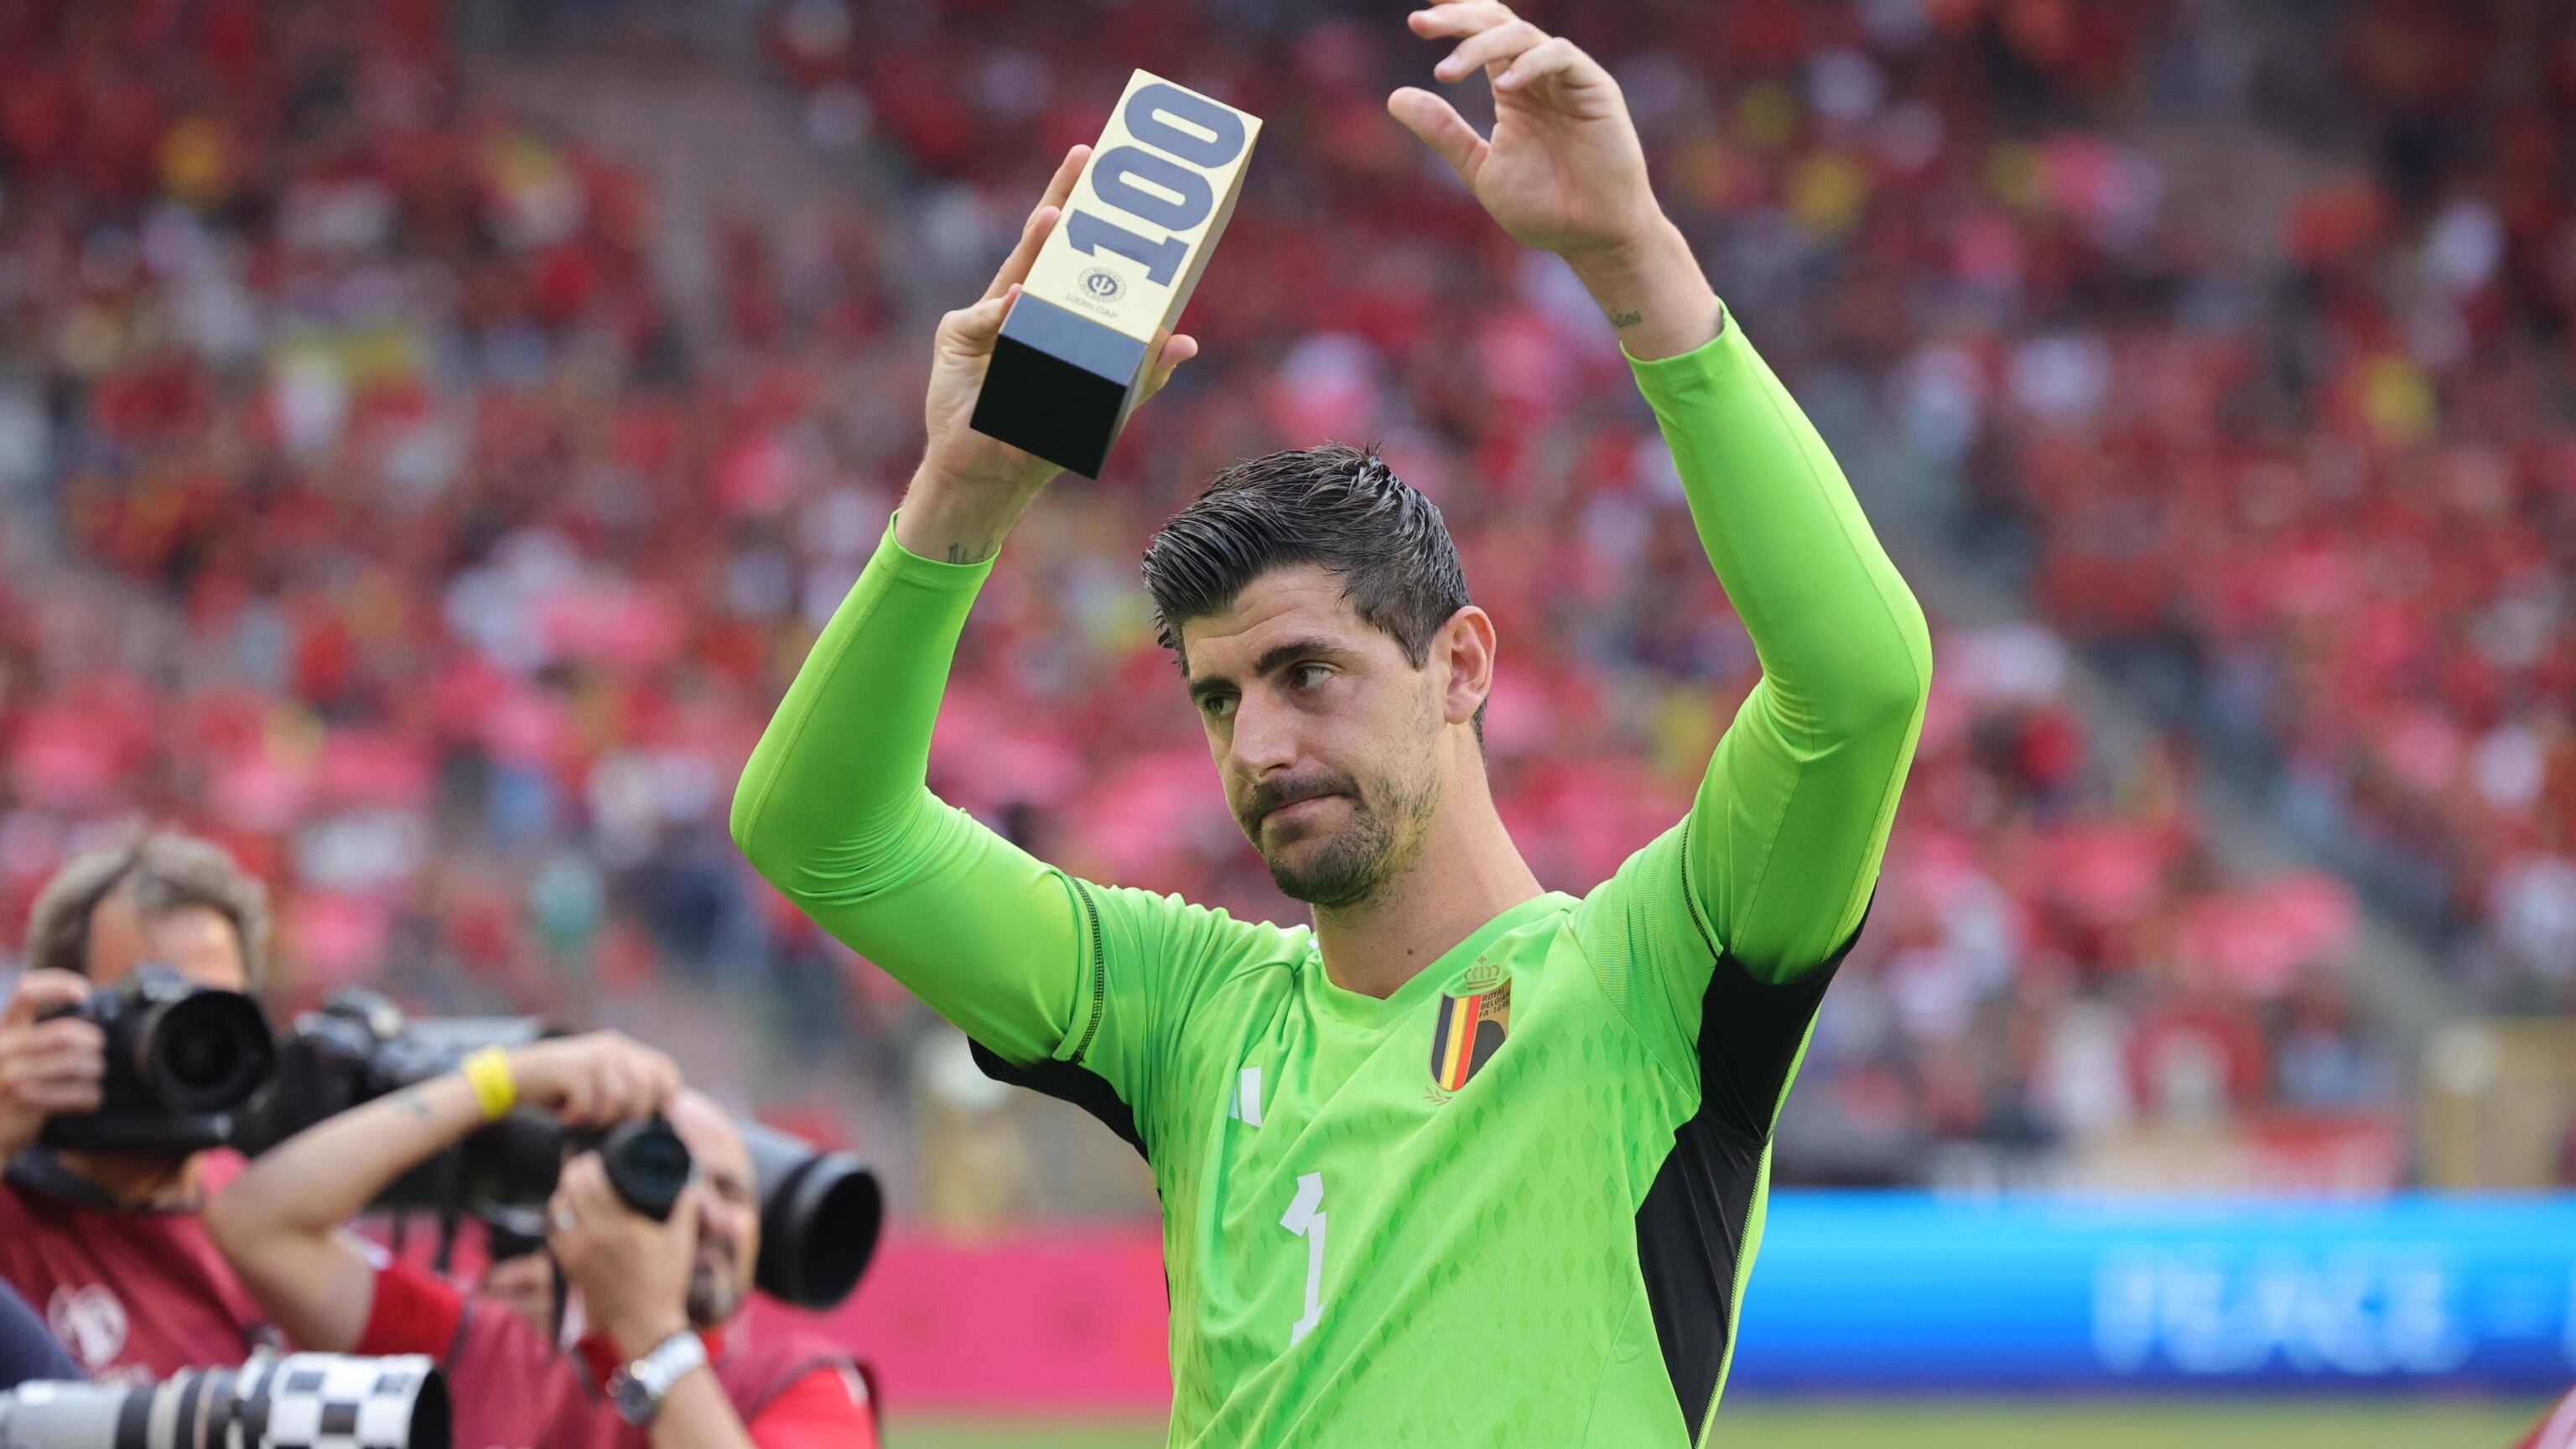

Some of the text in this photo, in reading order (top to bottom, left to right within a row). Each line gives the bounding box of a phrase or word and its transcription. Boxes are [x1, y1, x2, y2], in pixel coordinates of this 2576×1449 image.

[1067, 82, 1246, 287] 100
[1096, 306, 1118, 318] CAP
[1482, 987, 1504, 1002] ROYAL
[1280, 1171, 1327, 1347] 1
